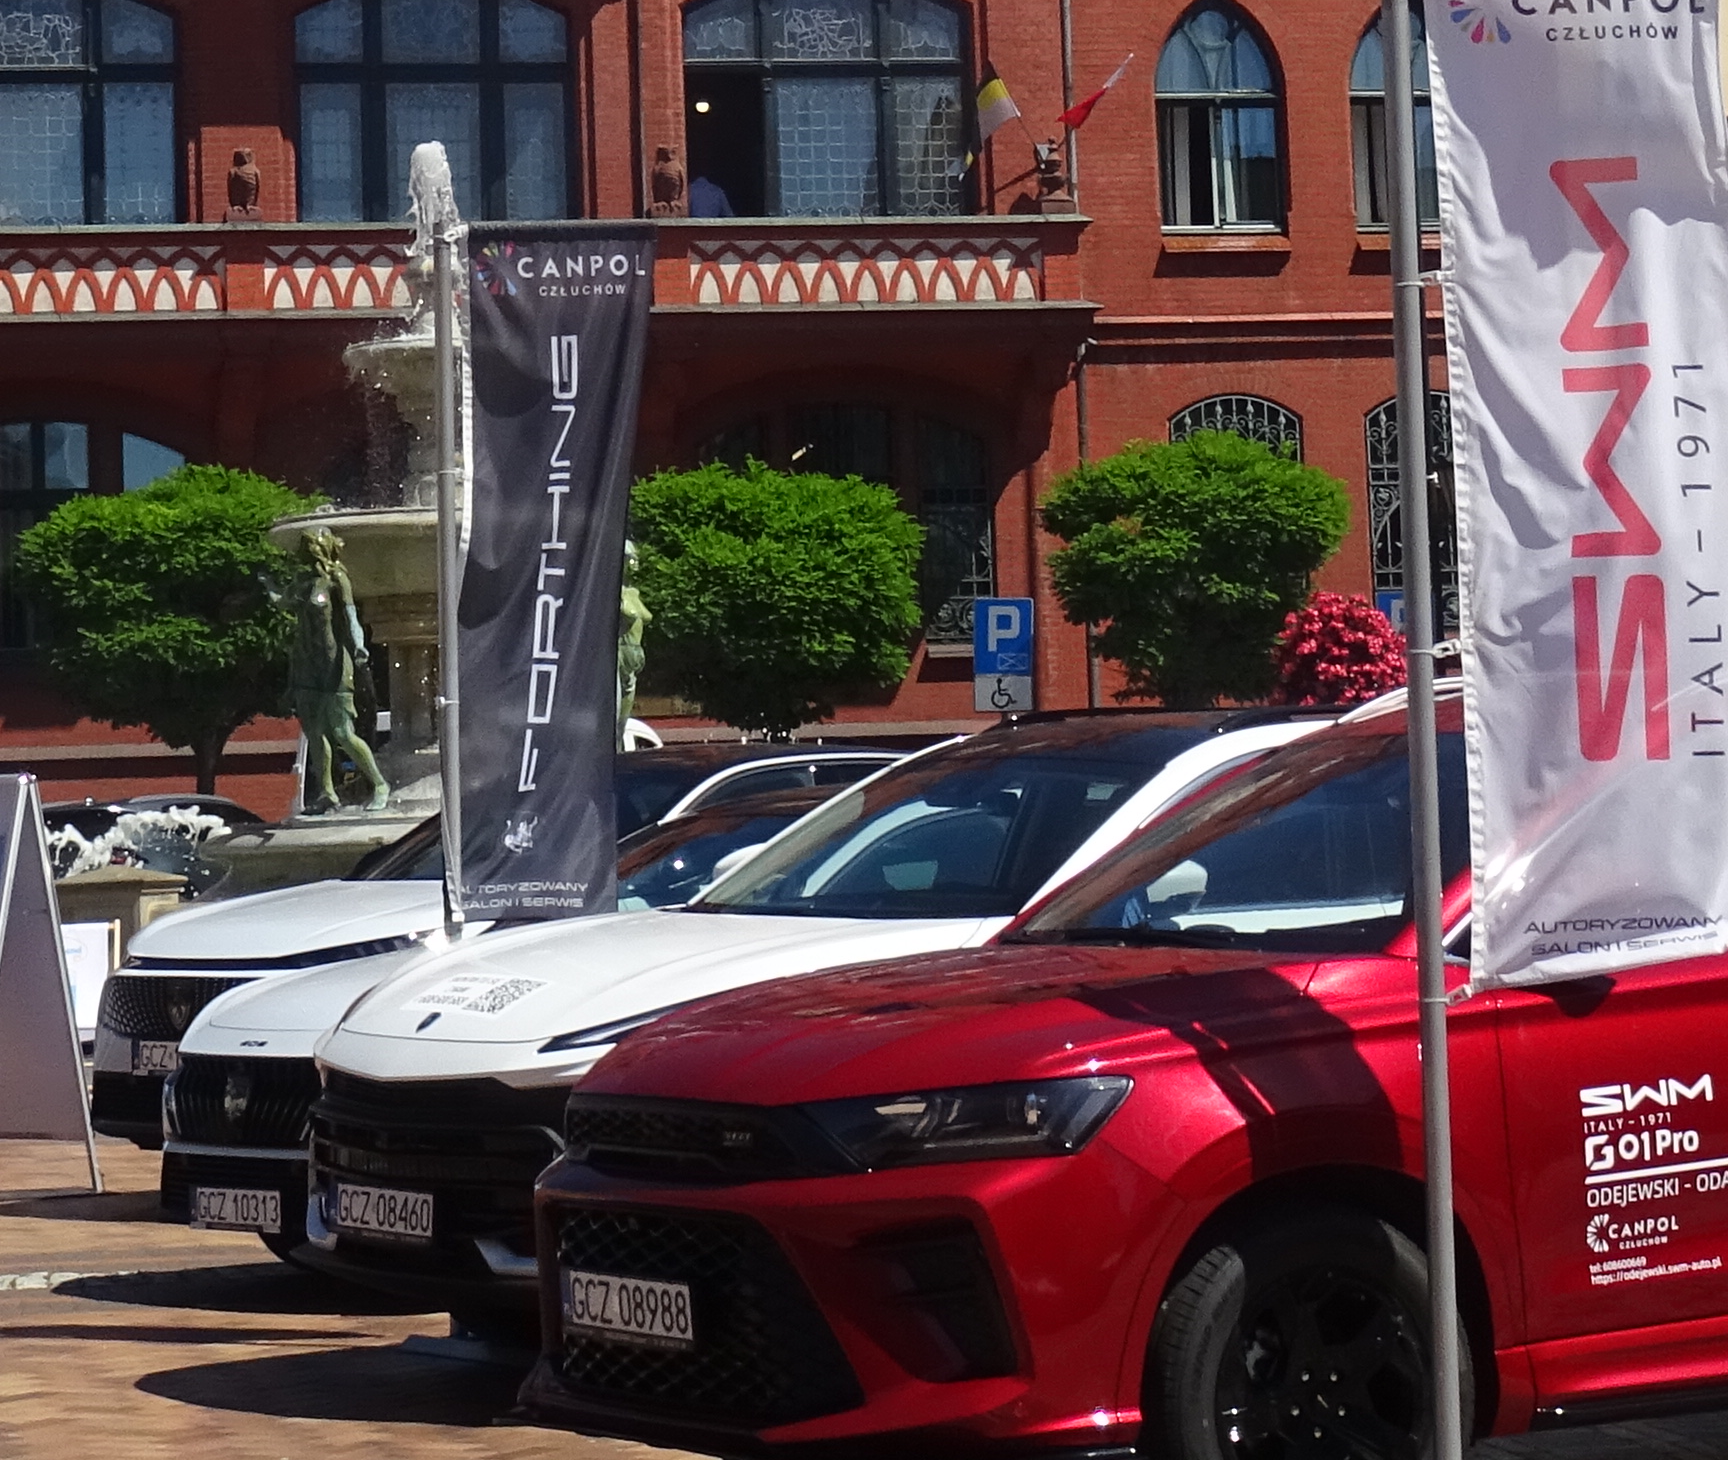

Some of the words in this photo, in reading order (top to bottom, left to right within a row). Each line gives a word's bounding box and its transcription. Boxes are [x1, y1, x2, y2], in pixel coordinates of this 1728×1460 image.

[1545, 21, 1679, 42] CZŁUCHÓW
[517, 253, 646, 279] CANPOL
[538, 282, 627, 297] CZŁUCHÓW
[1671, 363, 1713, 497] 1971
[518, 334, 580, 793] FORTHING
[987, 605, 1020, 652] P
[1686, 581, 1727, 757] ITALY
[522, 896, 584, 908] SERWIS
[140, 1043, 168, 1069] GCZ
[1579, 1073, 1714, 1118] SWM
[1583, 1118, 1624, 1134] ITALY
[1639, 1111, 1672, 1127] 1971
[1655, 1128, 1700, 1156] Pro
[197, 1192, 226, 1221] GCZ
[232, 1193, 280, 1224] 10313
[1586, 1177, 1680, 1208] ODEJEWSKI
[338, 1191, 370, 1225] GCZ
[375, 1193, 431, 1233] 08460
[1608, 1215, 1680, 1239] CANPOL
[572, 1276, 614, 1325] GCZ
[618, 1282, 689, 1335] 08988
